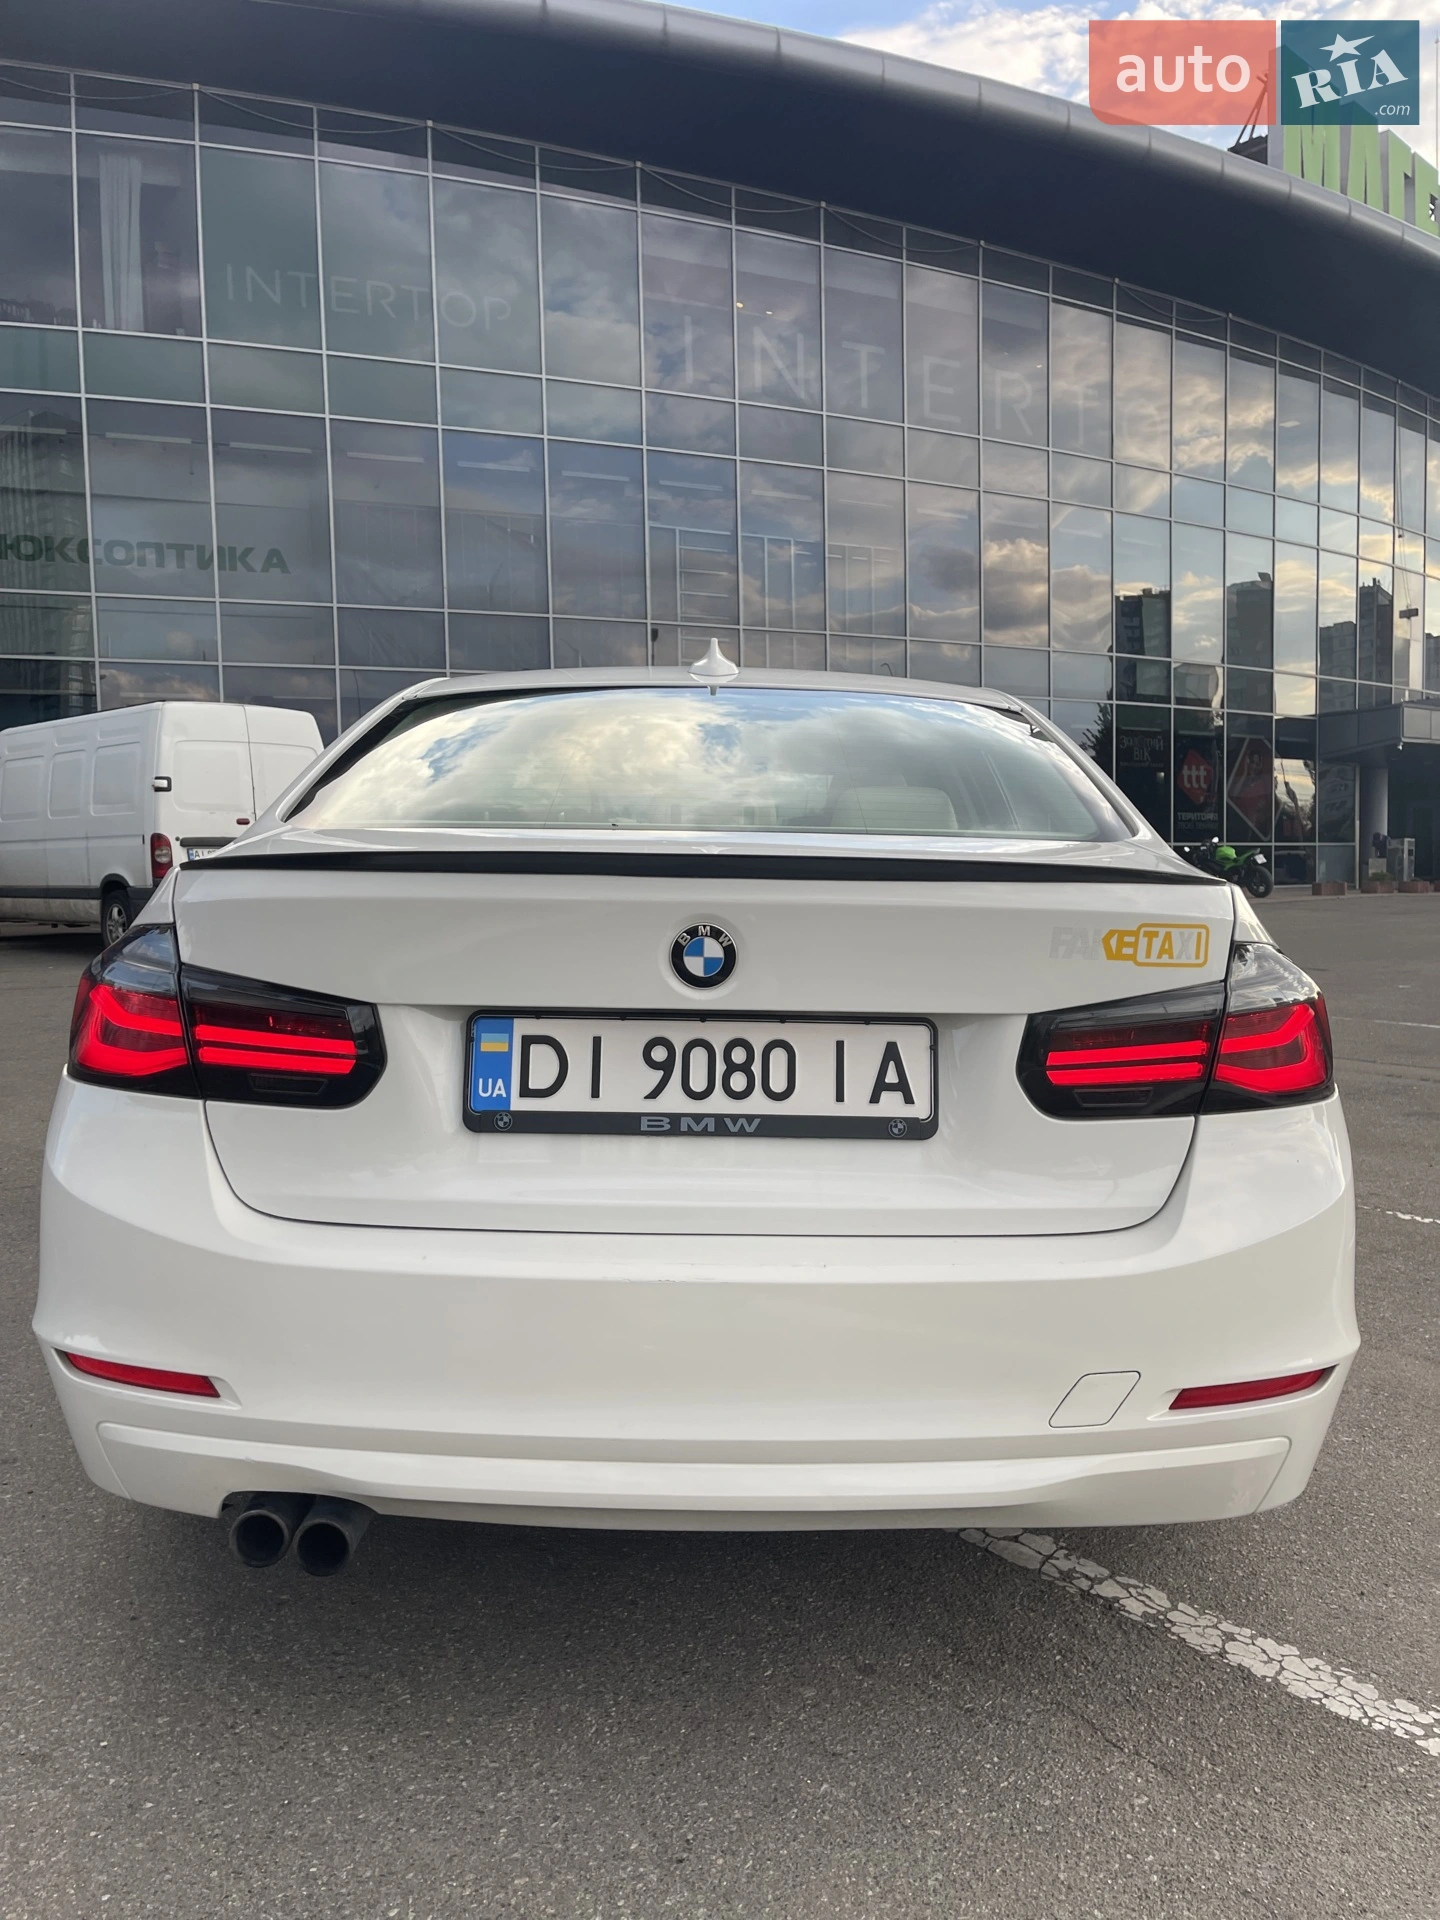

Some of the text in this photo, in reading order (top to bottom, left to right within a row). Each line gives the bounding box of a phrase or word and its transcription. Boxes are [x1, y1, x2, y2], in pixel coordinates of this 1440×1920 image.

[225, 262, 512, 331] INTERTOP
[0, 533, 292, 575] ЮКСОПТИКА
[1182, 765, 1207, 788] ttt
[677, 925, 733, 947] BMW
[518, 1034, 916, 1105] DI 9080 IA
[478, 1078, 507, 1099] UA
[640, 1116, 762, 1134] BMW
